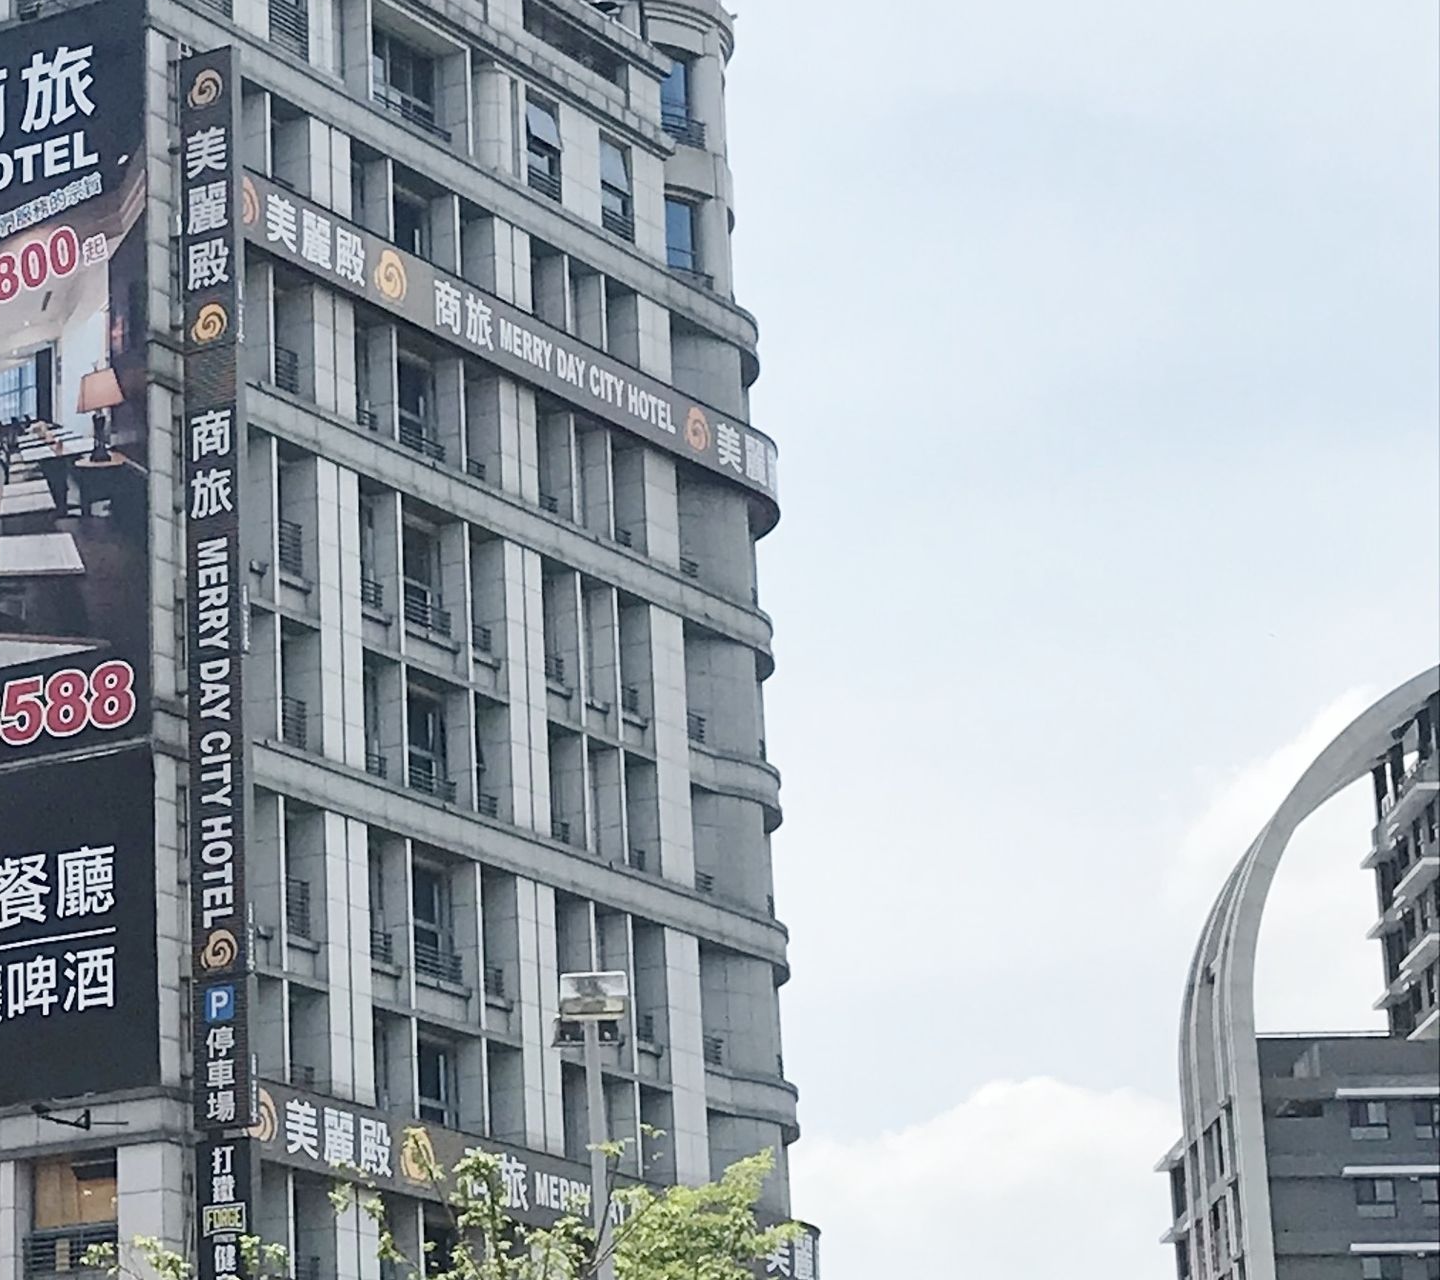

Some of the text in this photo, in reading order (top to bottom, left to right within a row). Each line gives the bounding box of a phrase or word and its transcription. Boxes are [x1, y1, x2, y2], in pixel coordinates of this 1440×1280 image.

[186, 126, 229, 293] 美麗殿
[266, 194, 366, 287] 美麗殿
[433, 279, 494, 352] 商旅
[500, 319, 676, 435] MERRY DAY CITY HOTEL
[190, 408, 233, 521] 商旅
[197, 537, 236, 930] MERRY DAY CITY HOTEL
[211, 991, 230, 1018] P
[205, 1025, 236, 1123] 停車場
[285, 1097, 393, 1180] 美麗殿
